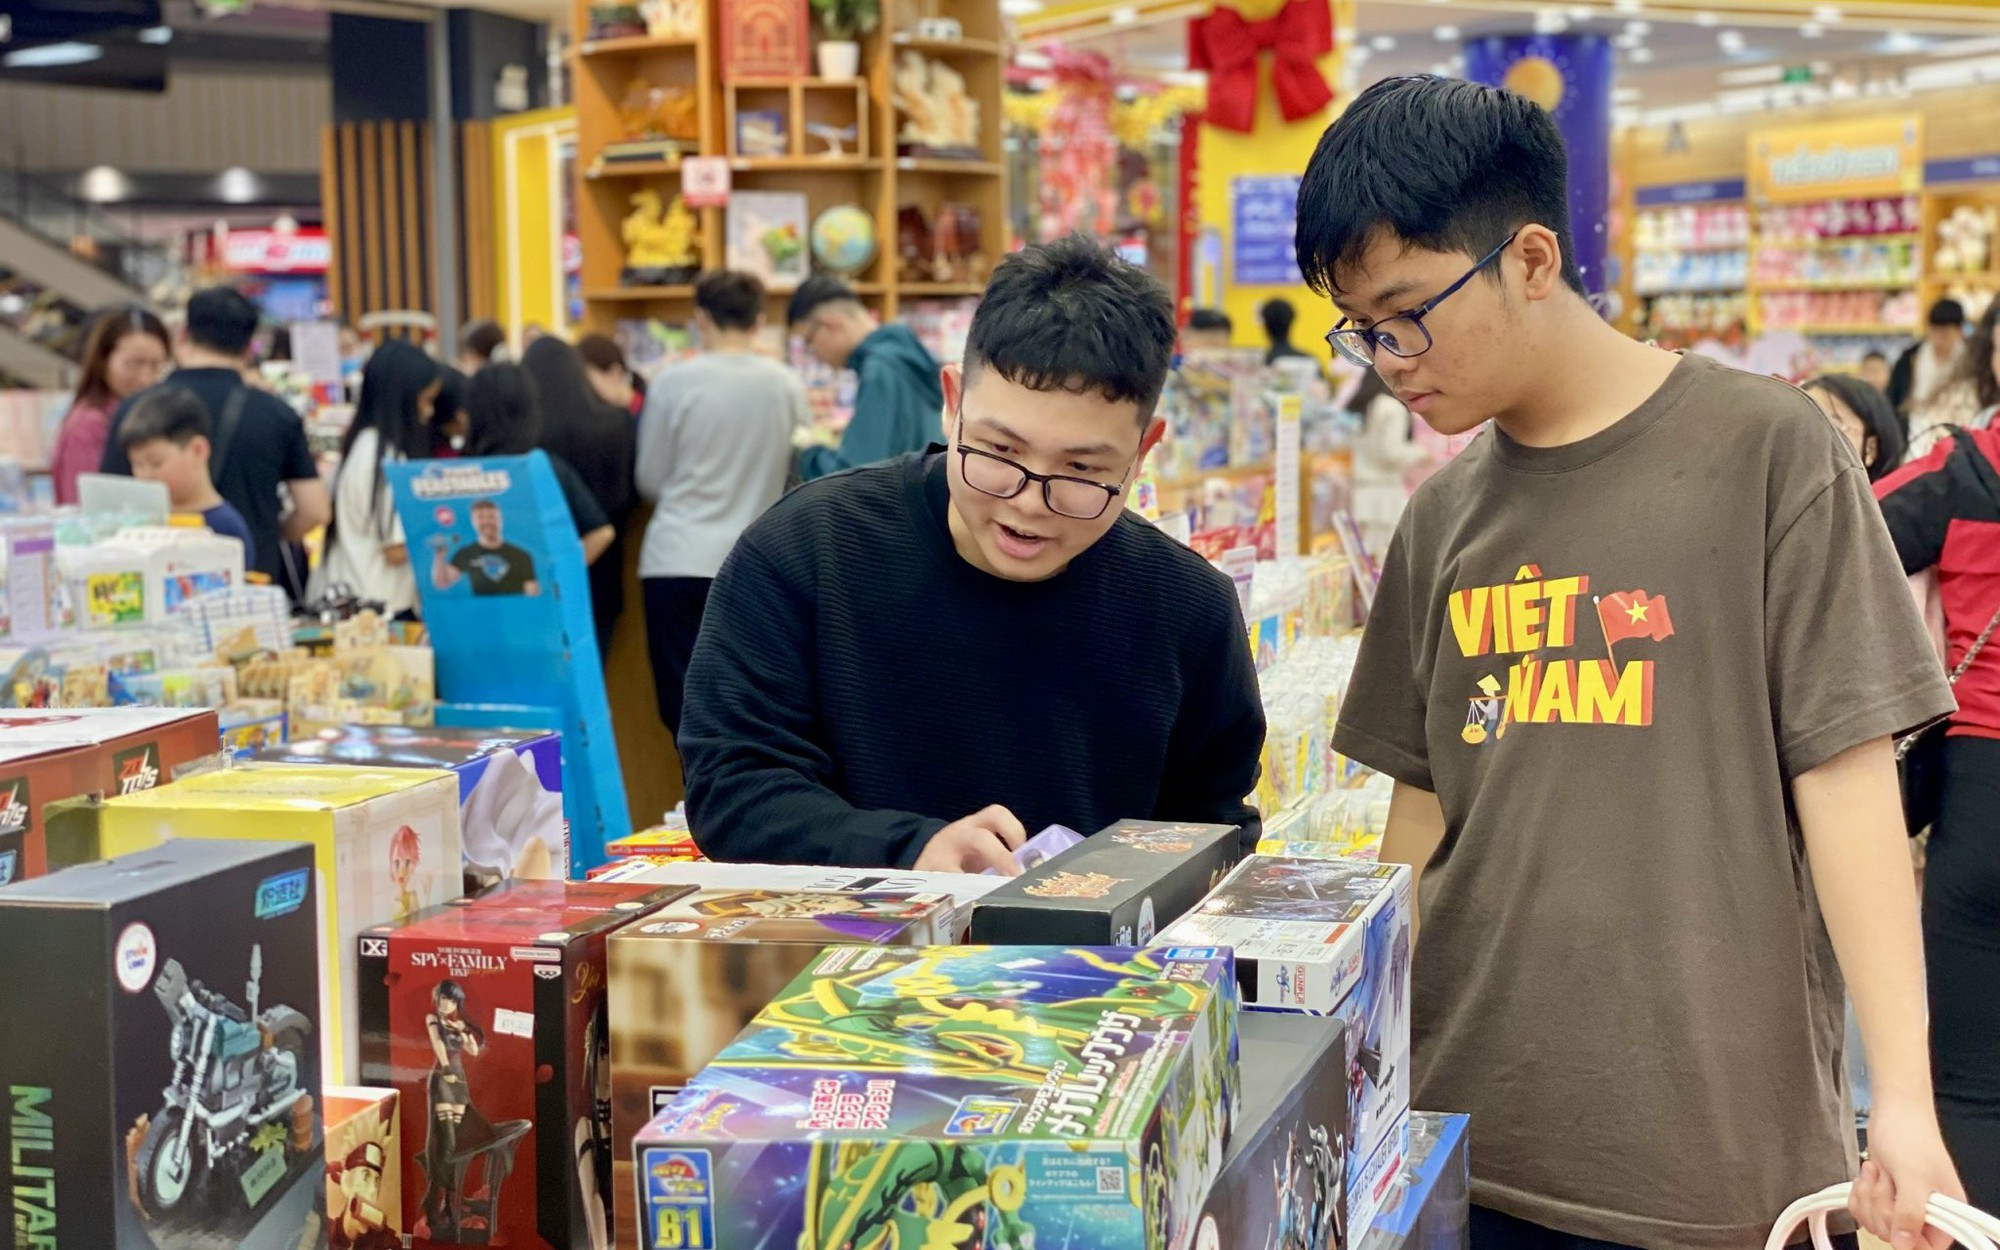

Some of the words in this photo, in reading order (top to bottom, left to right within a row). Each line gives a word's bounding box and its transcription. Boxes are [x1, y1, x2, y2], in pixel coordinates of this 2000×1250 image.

[1449, 564, 1589, 662] VIỆT
[1505, 660, 1655, 726] NAM
[1044, 1009, 1142, 1136] メガレックウザ
